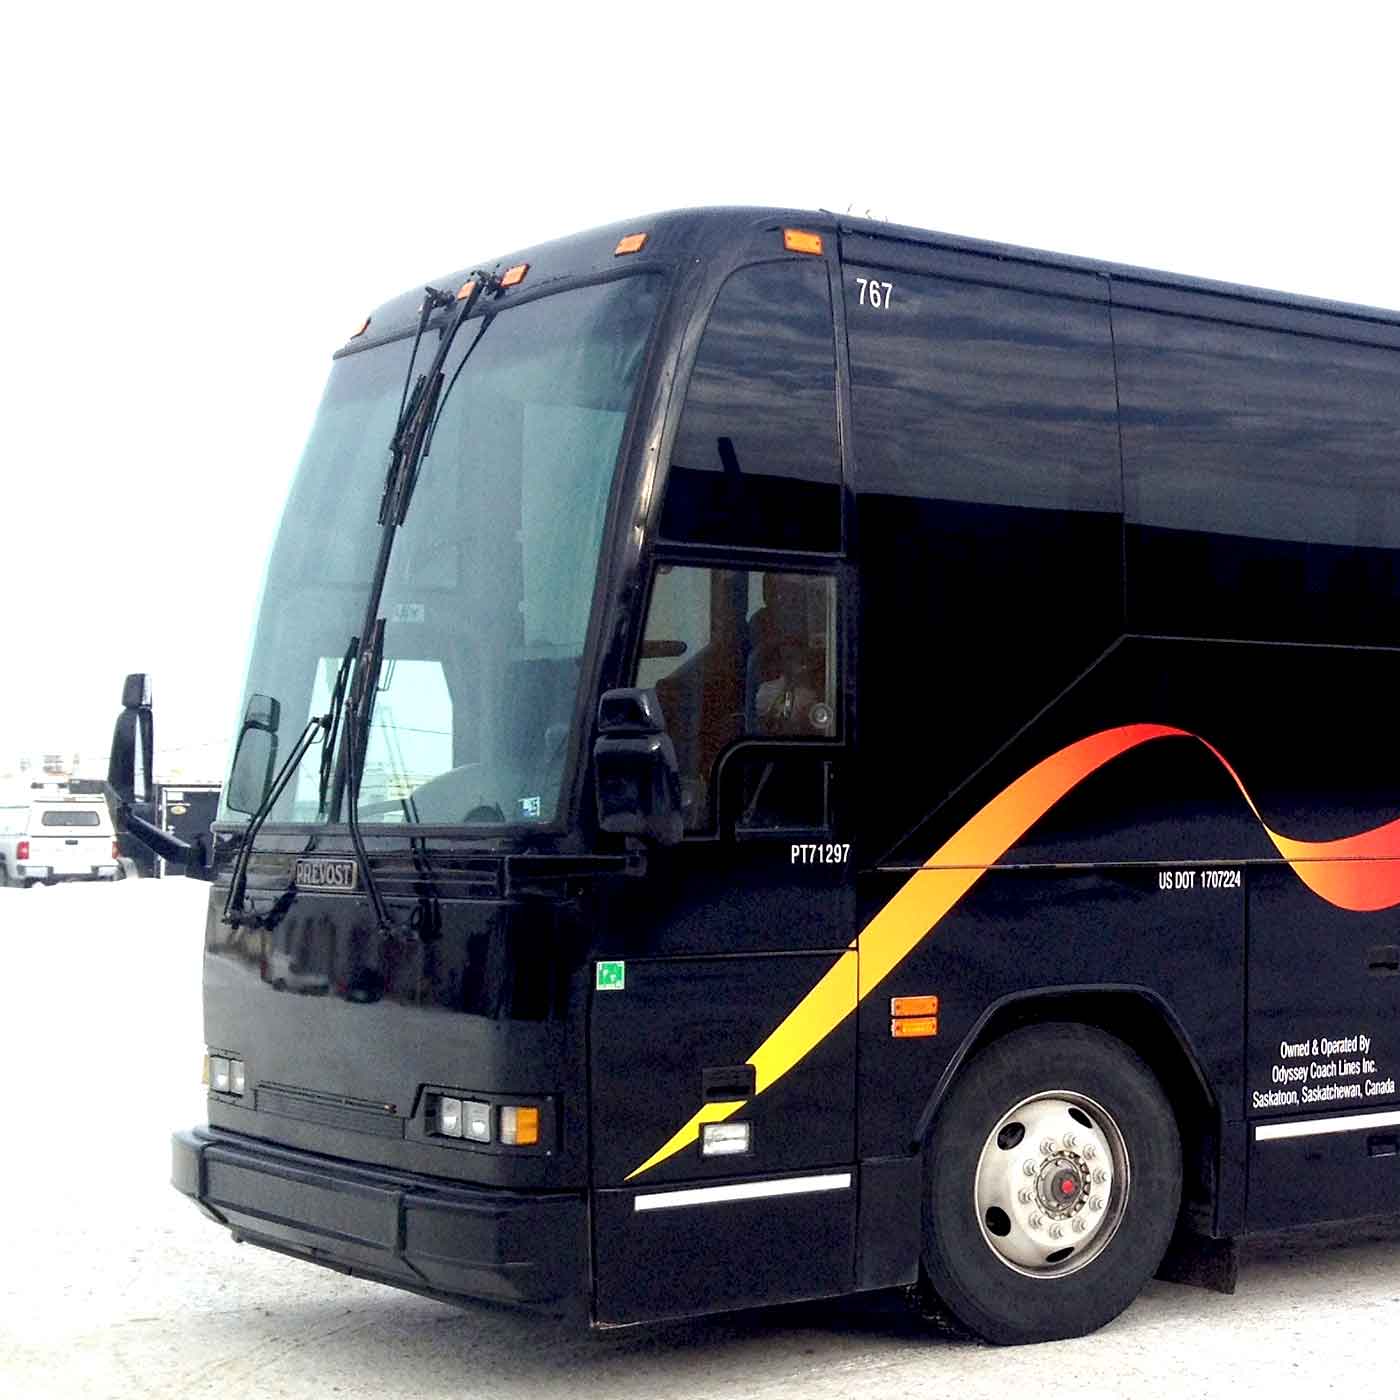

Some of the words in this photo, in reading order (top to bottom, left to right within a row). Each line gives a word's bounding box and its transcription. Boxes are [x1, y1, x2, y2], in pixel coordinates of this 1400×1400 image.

[856, 277, 893, 309] 767
[791, 843, 850, 864] PT71297
[1158, 871, 1173, 889] US
[1175, 871, 1196, 889] DOT
[1200, 870, 1241, 888] 1707224
[1280, 1040, 1310, 1059] Owned
[1312, 1038, 1319, 1056] &
[1320, 1036, 1358, 1057] Operated
[1359, 1034, 1371, 1054] By
[1272, 1065, 1309, 1085] Odyssey
[1310, 1060, 1337, 1079] Coach
[1338, 1059, 1361, 1076] Lines
[1362, 1057, 1378, 1073] Inc.
[1252, 1089, 1300, 1109] Saskatoon,
[1301, 1083, 1363, 1103] Saskatchewan,
[1365, 1077, 1396, 1096] Canada
